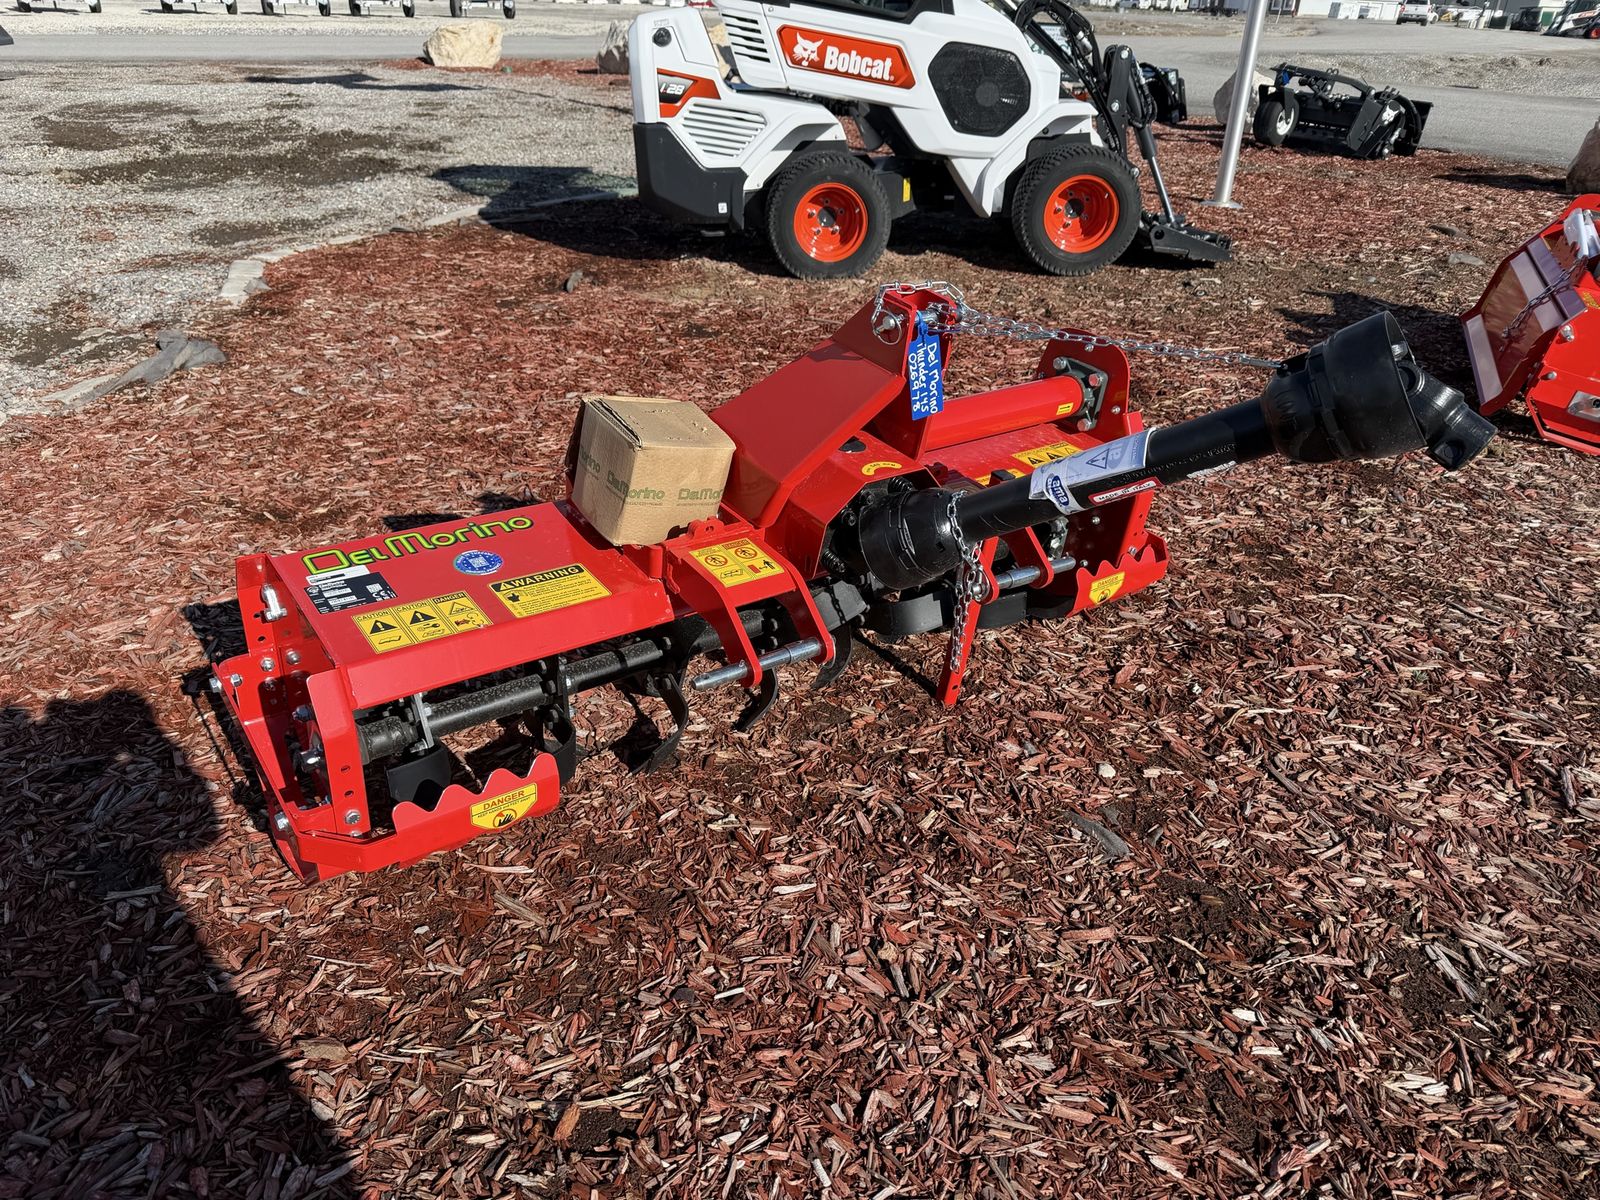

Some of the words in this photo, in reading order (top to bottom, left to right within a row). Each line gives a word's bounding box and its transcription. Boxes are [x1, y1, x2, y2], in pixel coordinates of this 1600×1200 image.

[824, 45, 893, 81] Bobcat
[927, 342, 939, 367] Del
[920, 391, 929, 413] 145
[928, 369, 940, 414] Morino
[1098, 492, 1119, 500] MADE
[1132, 482, 1151, 491] ITALY
[509, 566, 580, 587] WARNING
[396, 601, 428, 612] CAUTION
[433, 593, 466, 604] DANGER
[356, 610, 389, 621] CAUTION
[483, 790, 525, 811] DANGER
